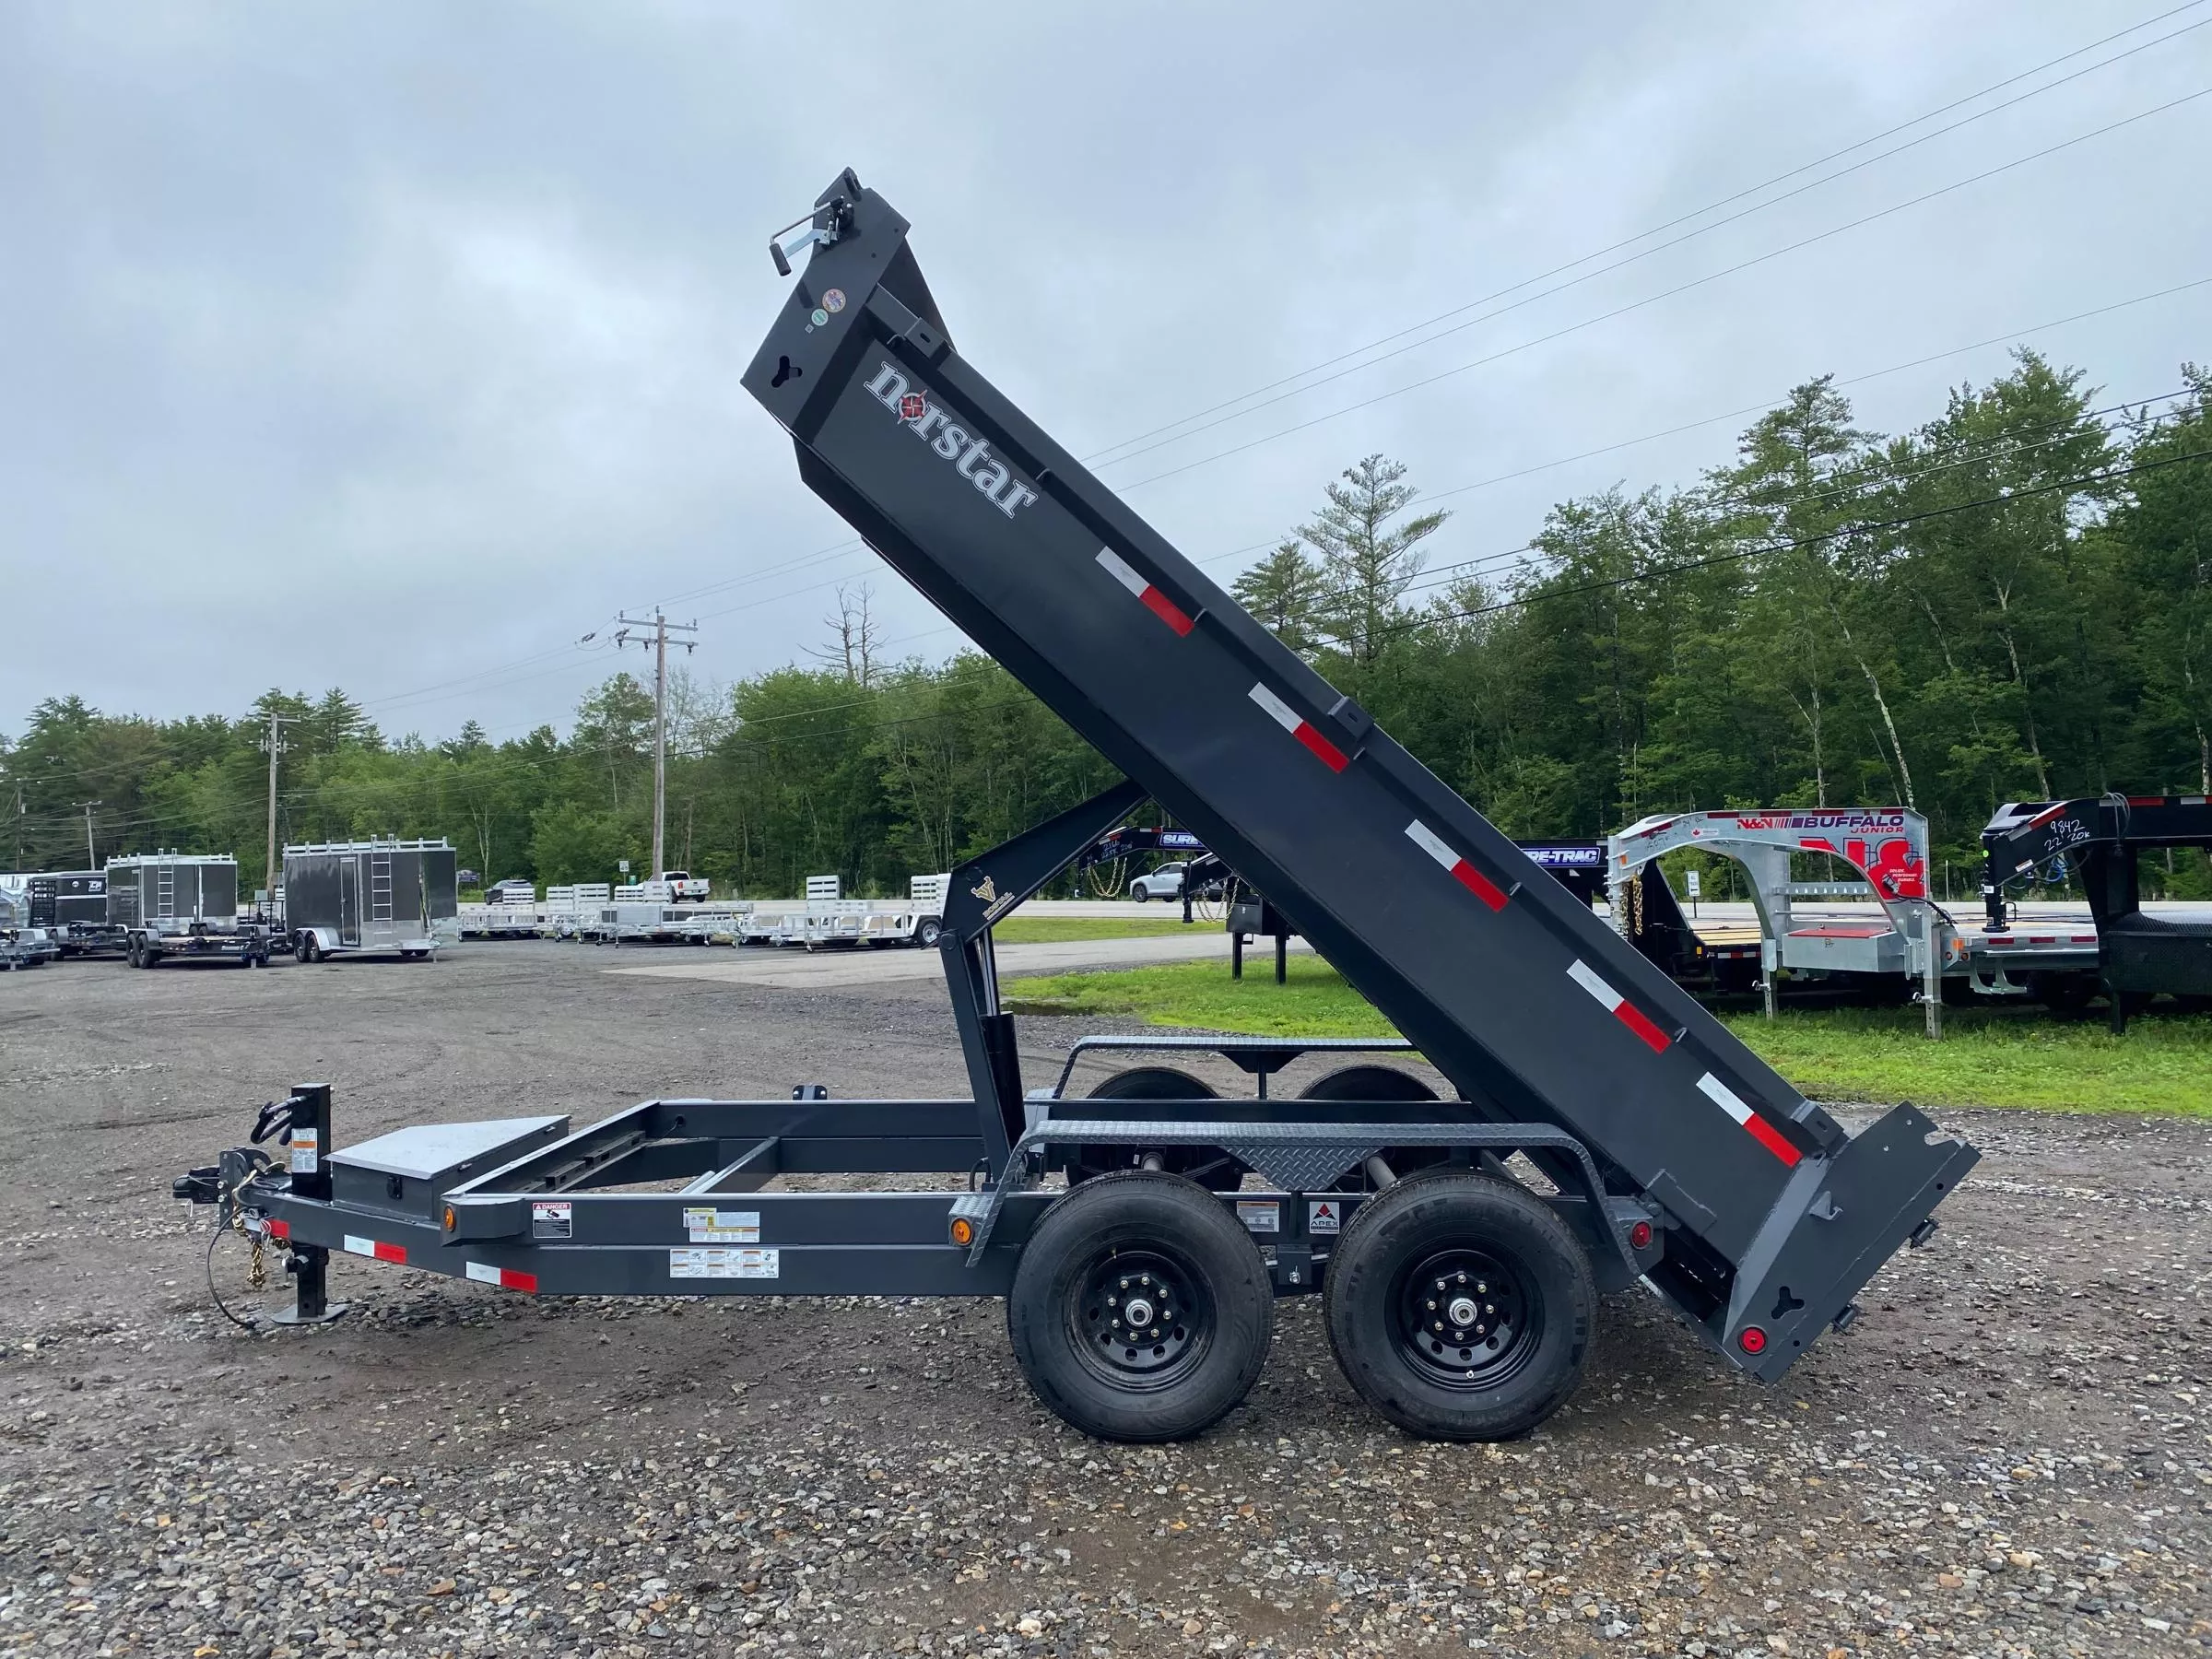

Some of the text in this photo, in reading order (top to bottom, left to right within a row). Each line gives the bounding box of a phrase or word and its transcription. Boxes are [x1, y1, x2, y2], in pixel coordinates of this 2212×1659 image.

[863, 360, 1039, 520] norstar
[1737, 816, 1904, 830] N&N BUFFALO
